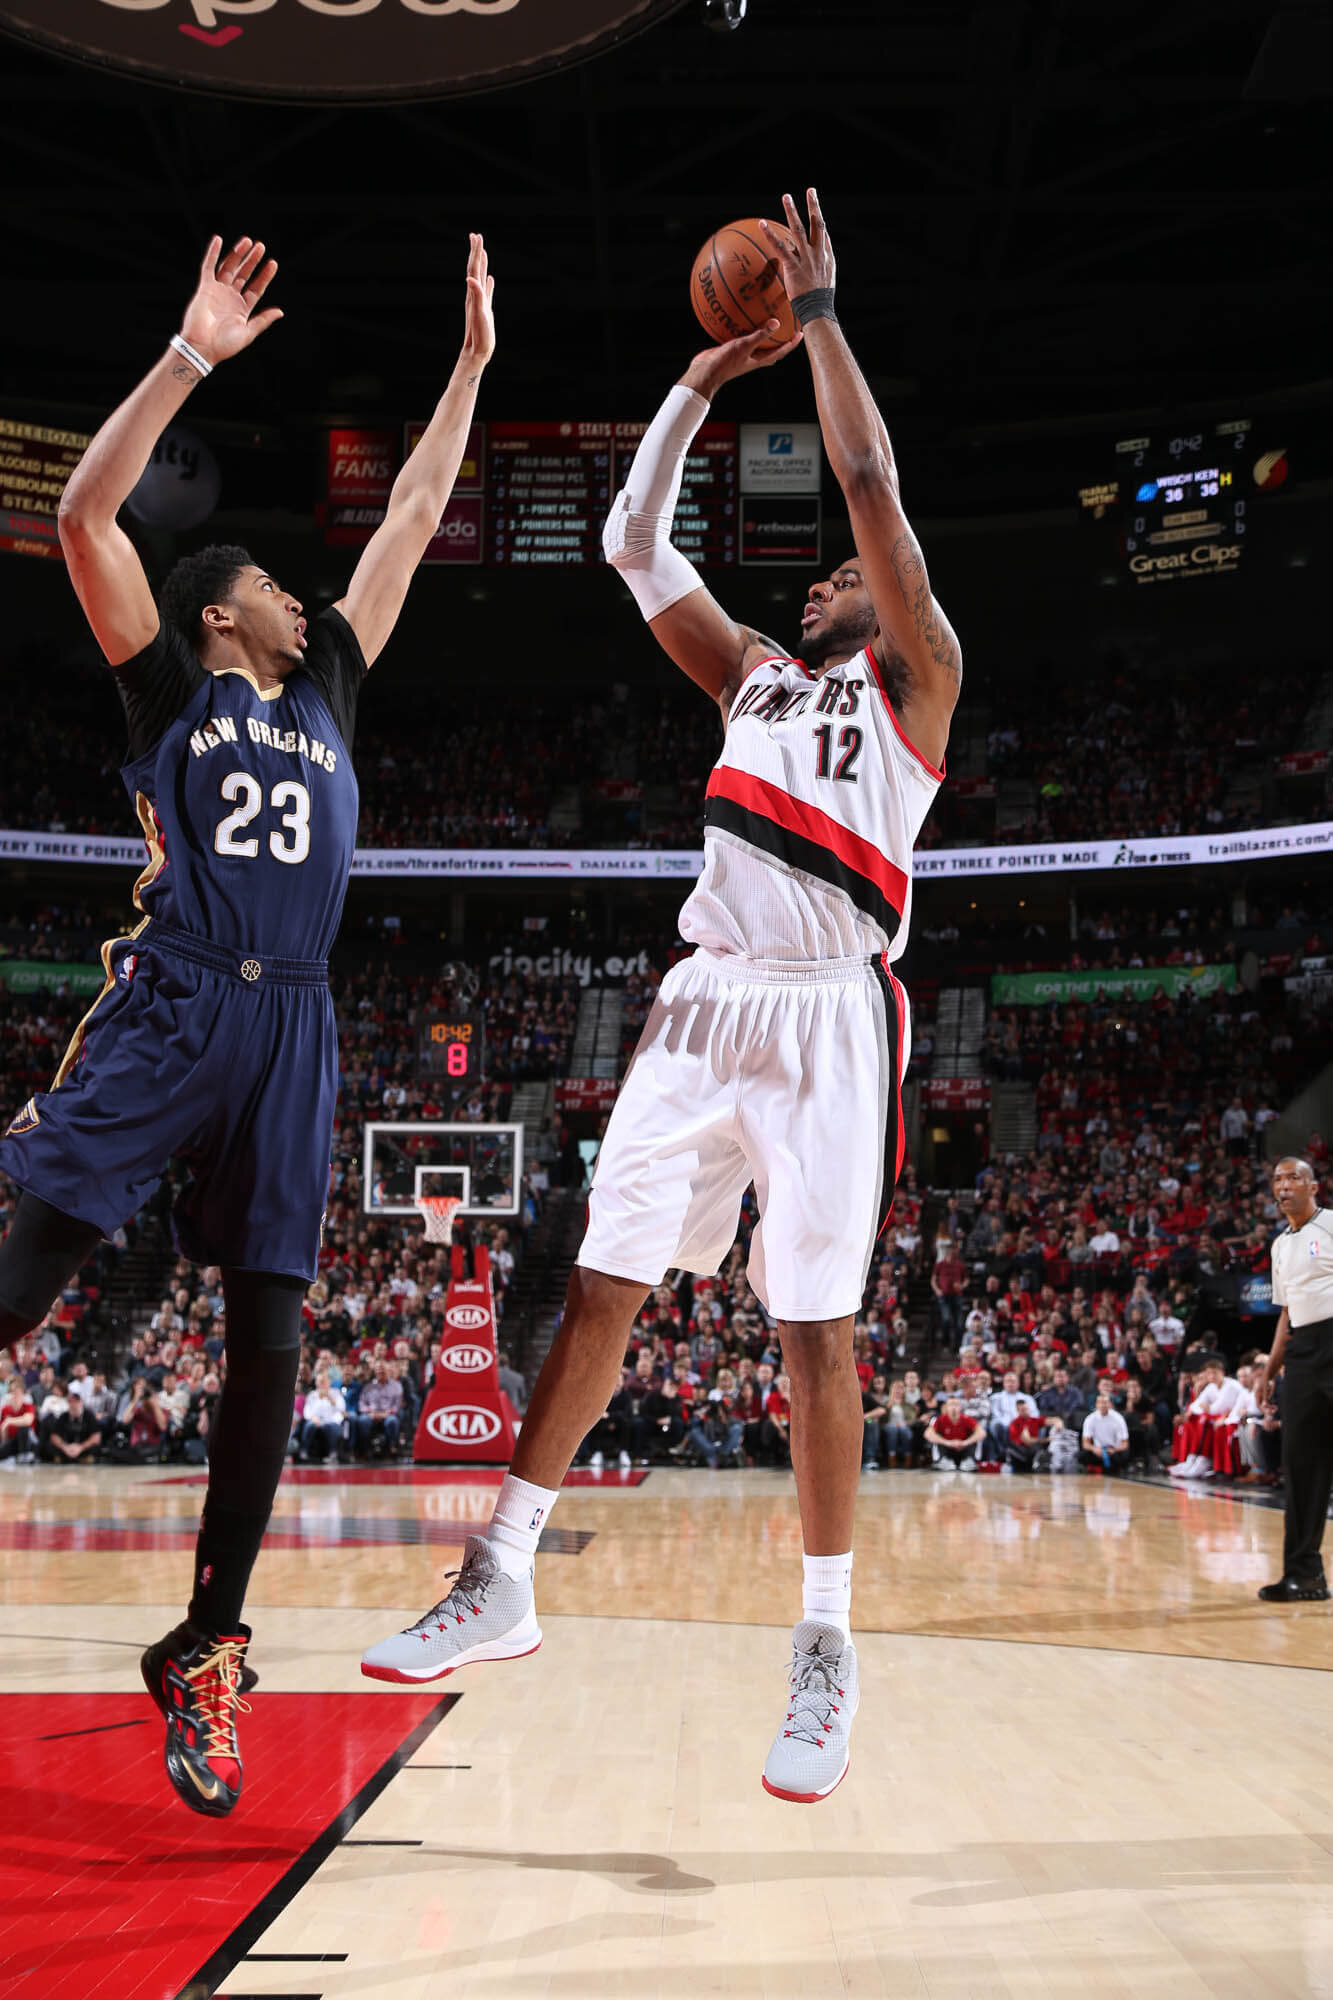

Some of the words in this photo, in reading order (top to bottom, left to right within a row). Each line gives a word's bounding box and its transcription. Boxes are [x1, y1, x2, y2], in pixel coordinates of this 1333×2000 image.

[332, 459, 390, 480] FANS
[1129, 552, 1189, 573] Great
[1190, 545, 1241, 570] Clips
[190, 717, 238, 758] NEW
[247, 717, 337, 774] ORLEANS
[813, 721, 865, 784] 12
[215, 771, 311, 865] 23
[35, 842, 78, 856] THREE
[84, 845, 145, 859] POINTER
[952, 857, 992, 870] THREE
[998, 853, 1056, 868] POINTER
[1062, 851, 1100, 863] MADE
[580, 861, 648, 870] DAIMLER
[1033, 982, 1063, 995] FOR
[1064, 980, 1092, 993] THE
[430, 1023, 473, 1043] 10:42
[447, 1043, 467, 1076] 8
[453, 1310, 483, 1323] KIA
[448, 1351, 484, 1367] KIA
[439, 1414, 489, 1436] KIA
